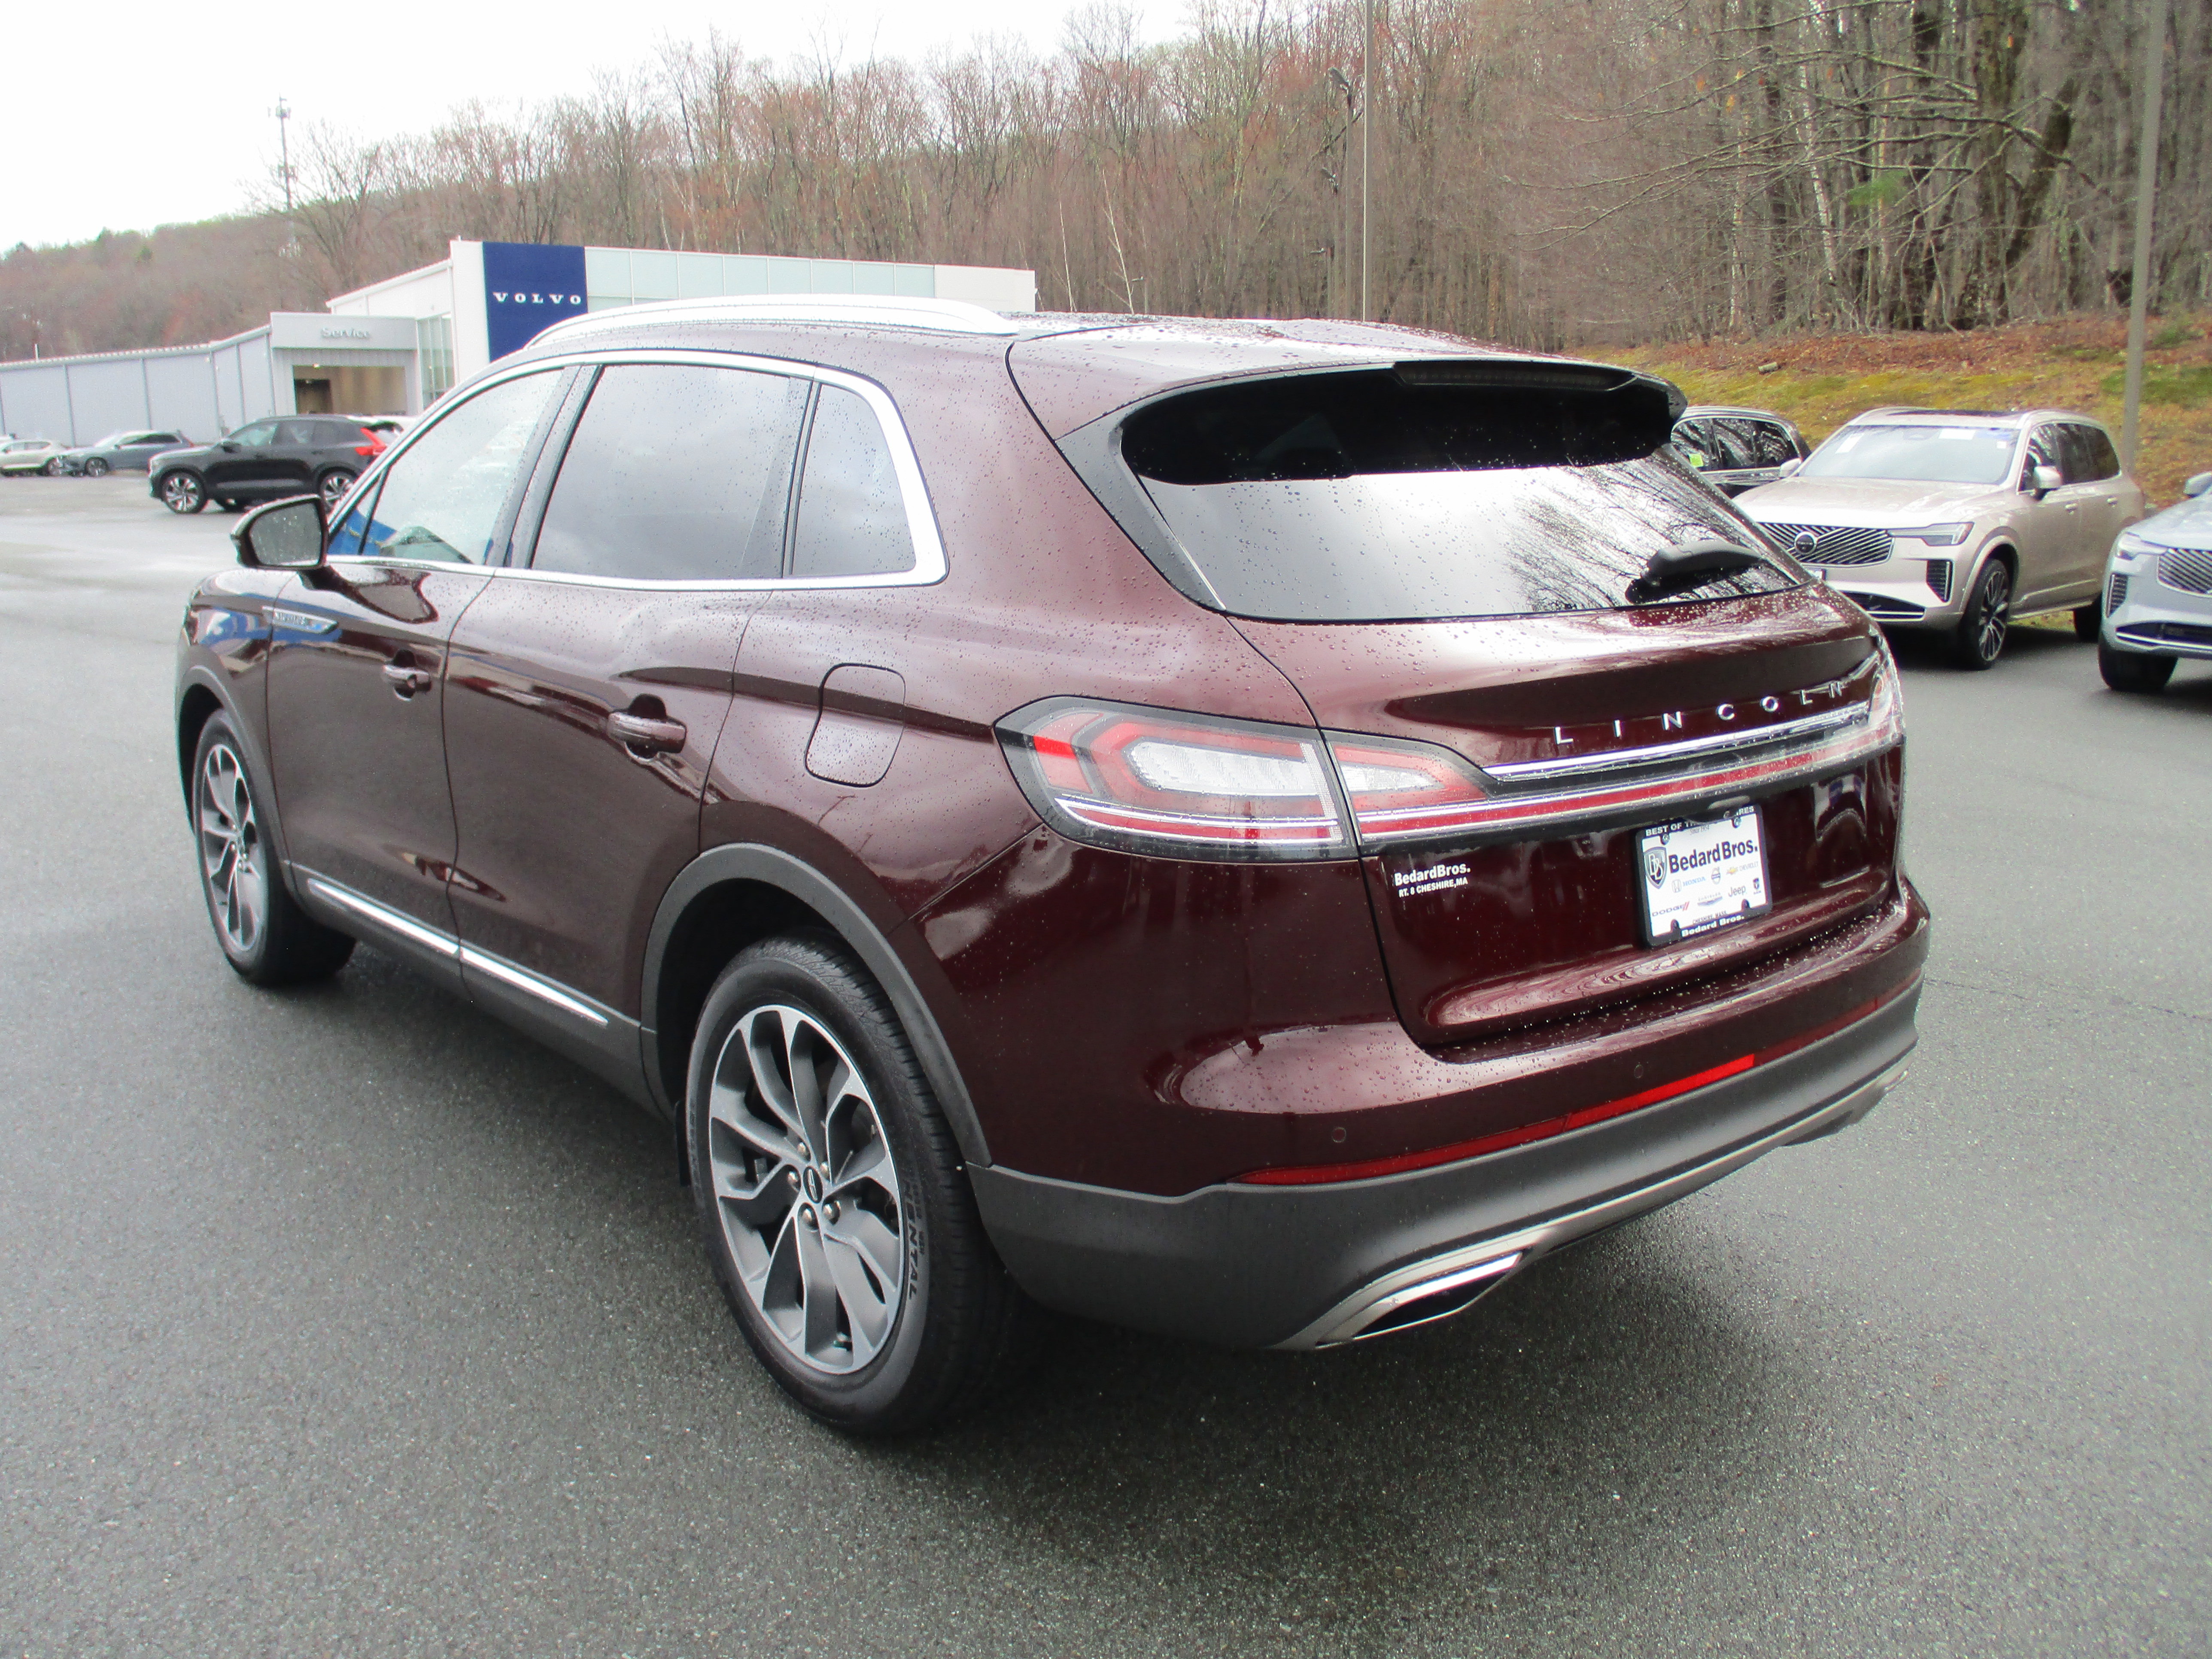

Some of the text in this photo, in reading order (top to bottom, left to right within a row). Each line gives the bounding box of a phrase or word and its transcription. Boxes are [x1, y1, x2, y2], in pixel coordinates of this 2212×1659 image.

[493, 292, 581, 304] VOLVO
[321, 327, 371, 339] Service
[1554, 681, 1843, 745] LINCOLN
[1645, 824, 1668, 837] BEST
[1670, 822, 1682, 830] OF
[1683, 876, 1706, 887] HONDA
[1398, 888, 1409, 898] RT.
[1410, 887, 1415, 895] 8
[1728, 885, 1746, 897] Jeep
[1652, 904, 1685, 917] DODGE
[1681, 915, 1745, 937] Bedard Bros.
